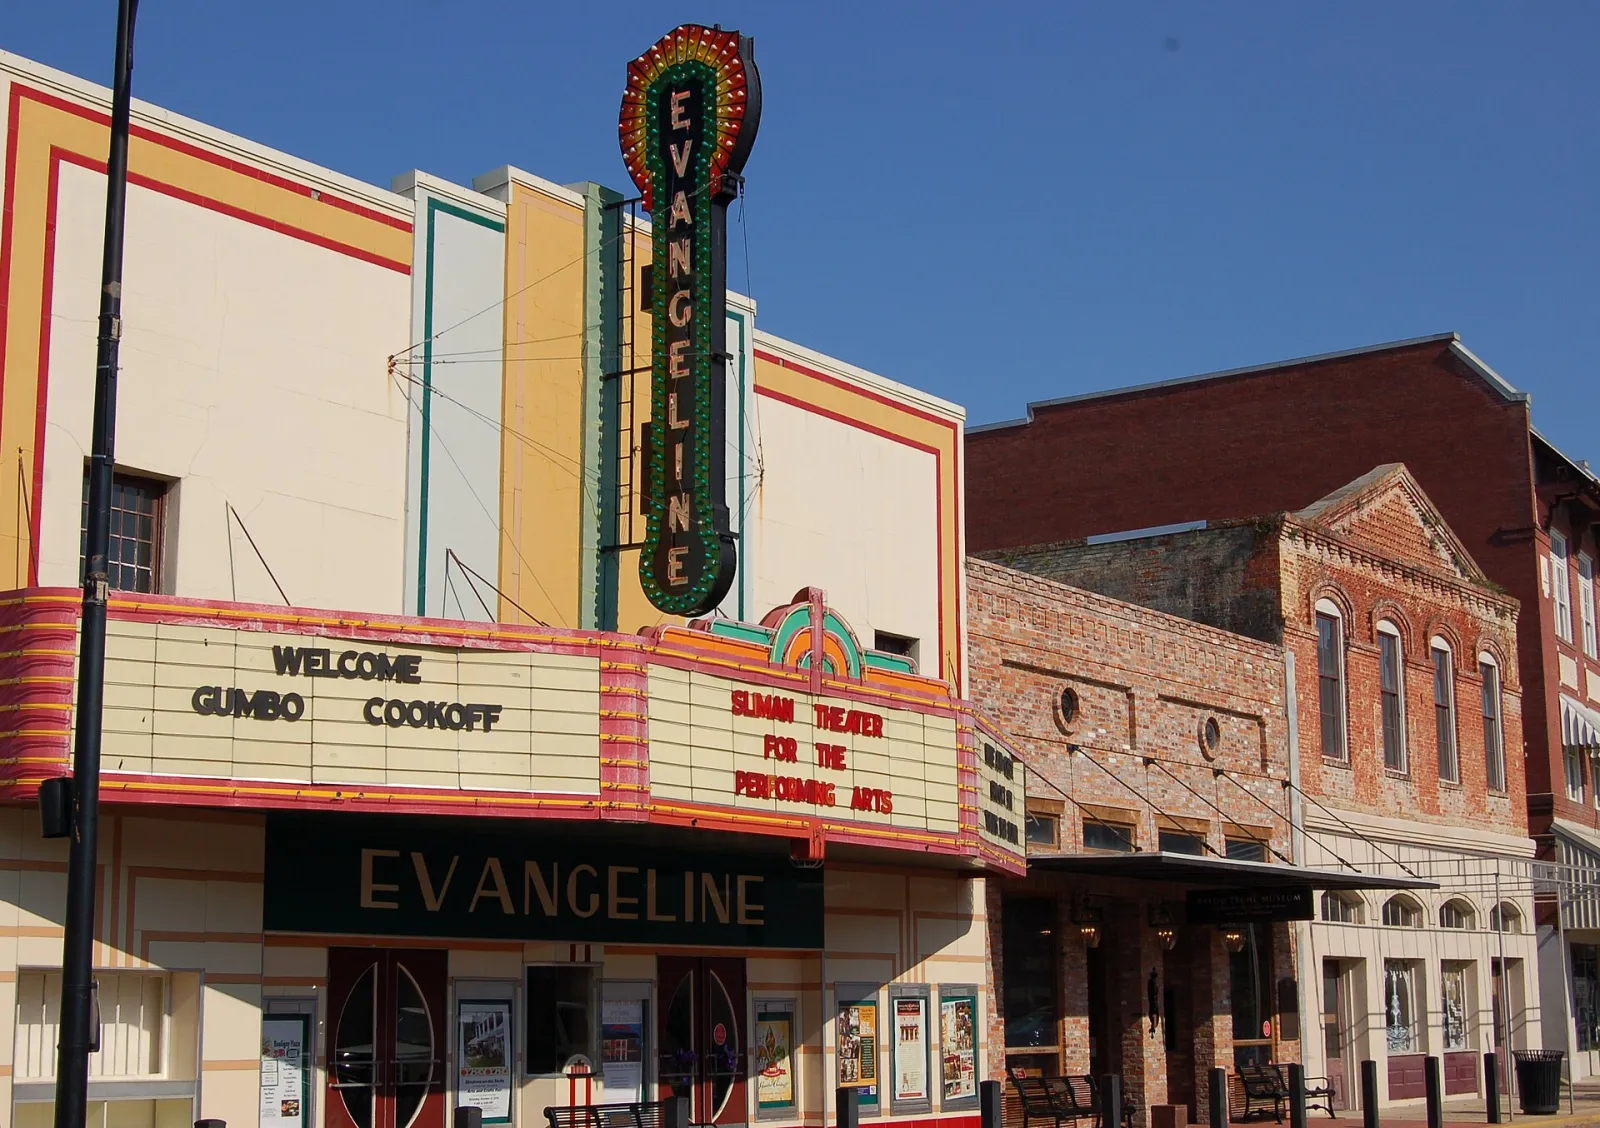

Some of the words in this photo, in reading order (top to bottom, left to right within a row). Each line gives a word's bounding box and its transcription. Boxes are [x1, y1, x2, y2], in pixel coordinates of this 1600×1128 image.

[667, 88, 692, 586] EVANGELINE
[272, 645, 421, 684] WELCOME
[191, 686, 304, 722] GUMBO
[363, 698, 502, 733] COOKOFF
[731, 690, 794, 724] SLIMAN
[814, 704, 884, 738] THEATER
[764, 734, 798, 763] FOR
[815, 741, 847, 771] THE
[734, 771, 836, 806] PERFORMING
[850, 786, 893, 815] ARTS
[360, 847, 765, 926] EVANGELINE
[1261, 894, 1301, 903] MUSEUM
